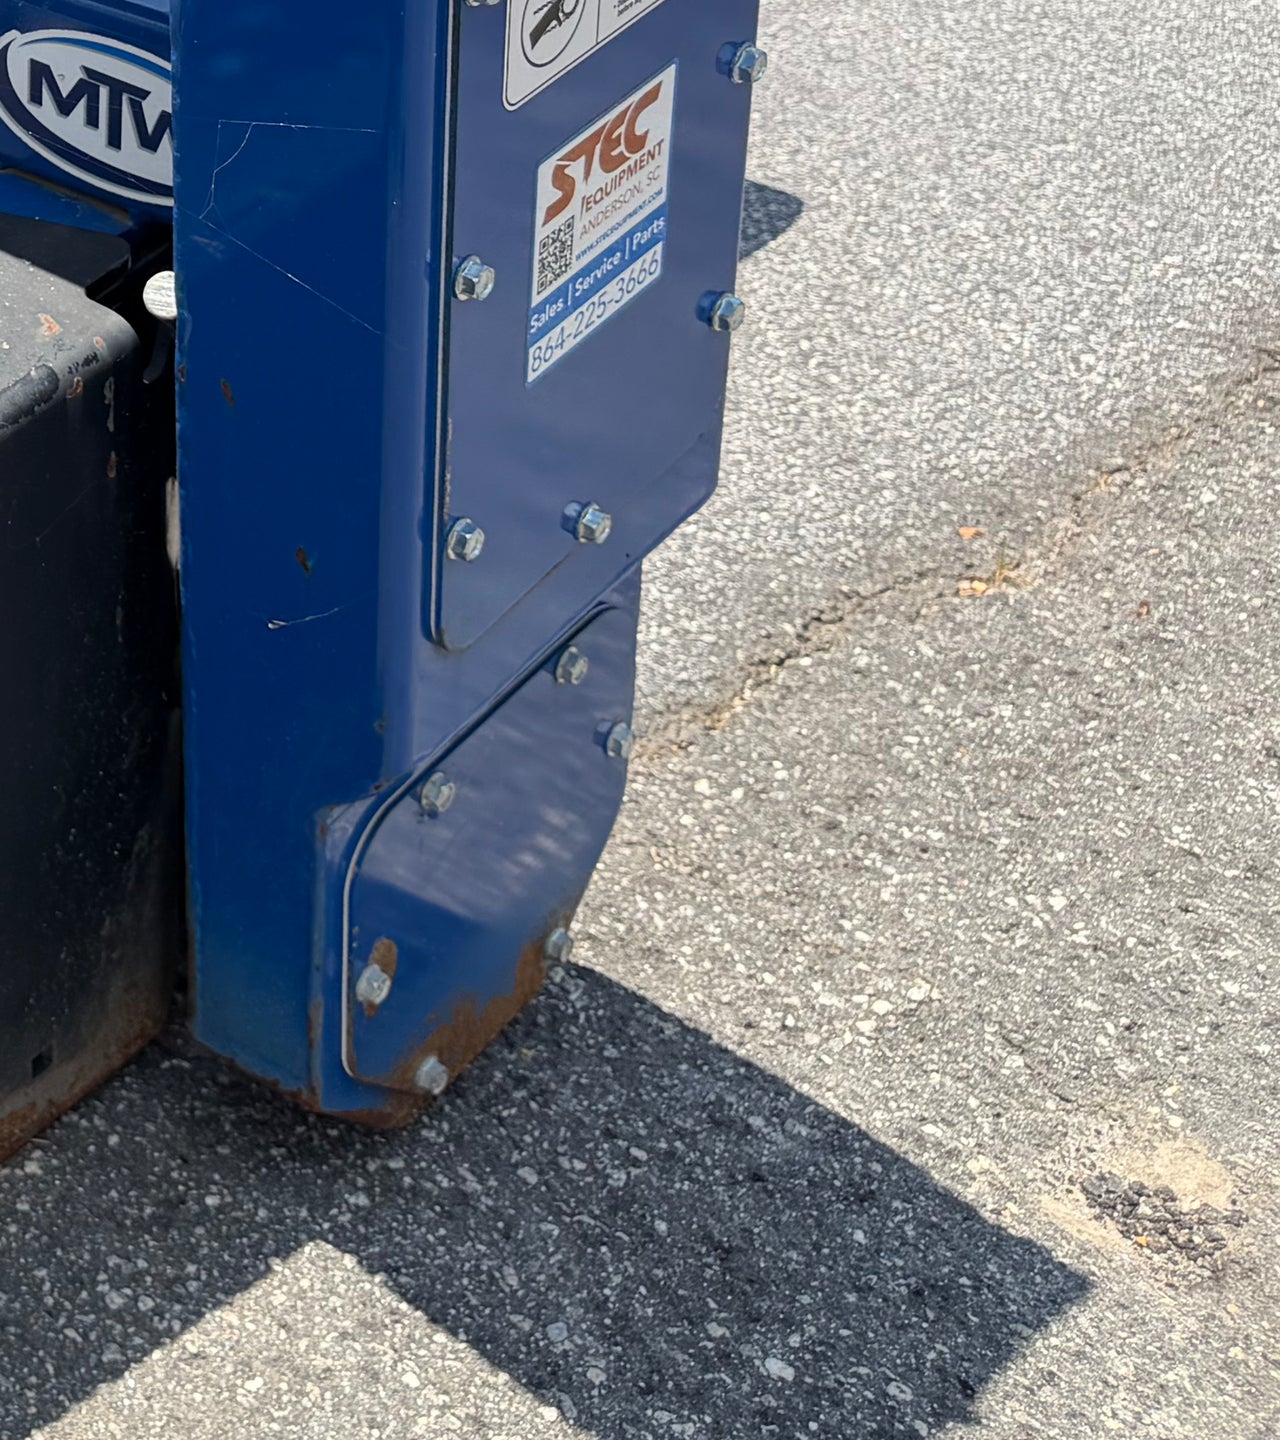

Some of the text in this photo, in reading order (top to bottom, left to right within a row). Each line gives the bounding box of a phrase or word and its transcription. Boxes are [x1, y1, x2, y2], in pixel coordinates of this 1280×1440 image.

[541, 80, 664, 228] STEC
[578, 165, 661, 240] ANDERSON, SC
[583, 137, 665, 214] EQUIPMENT
[530, 216, 666, 333] Sales Service Parts
[531, 250, 658, 373] 864-225-3666
